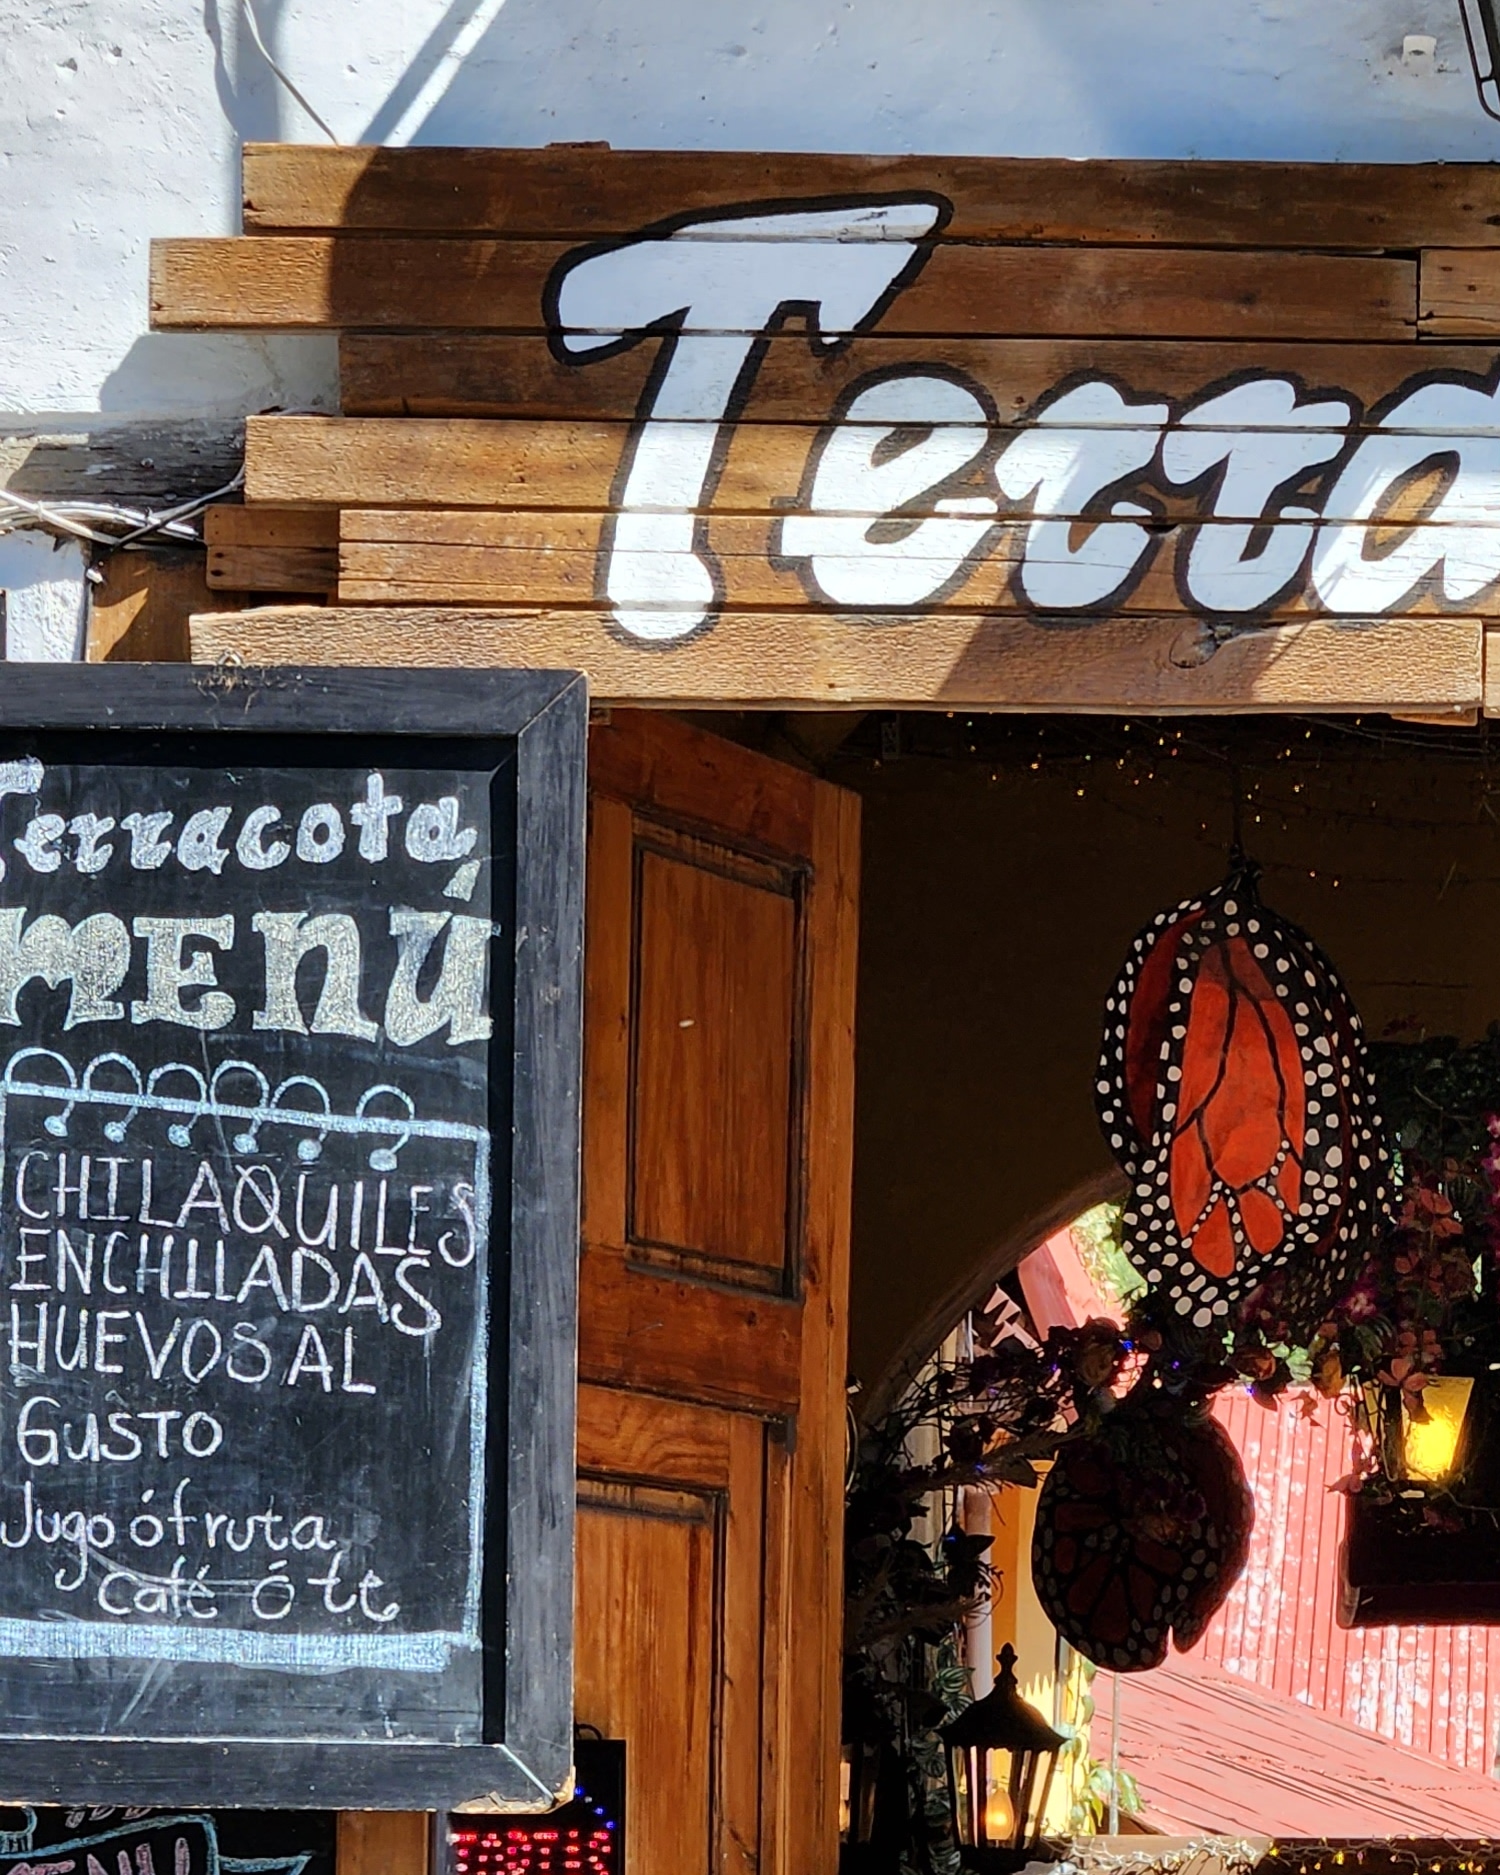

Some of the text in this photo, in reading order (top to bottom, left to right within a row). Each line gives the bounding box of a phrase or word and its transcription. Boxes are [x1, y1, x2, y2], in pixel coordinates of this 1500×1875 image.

[15, 1151, 476, 1268] CHILAQUILES
[9, 1228, 443, 1337] ENCHILADAS
[8, 1301, 377, 1394] HUEVOS AL
[0, 1481, 116, 1591] Jugo
